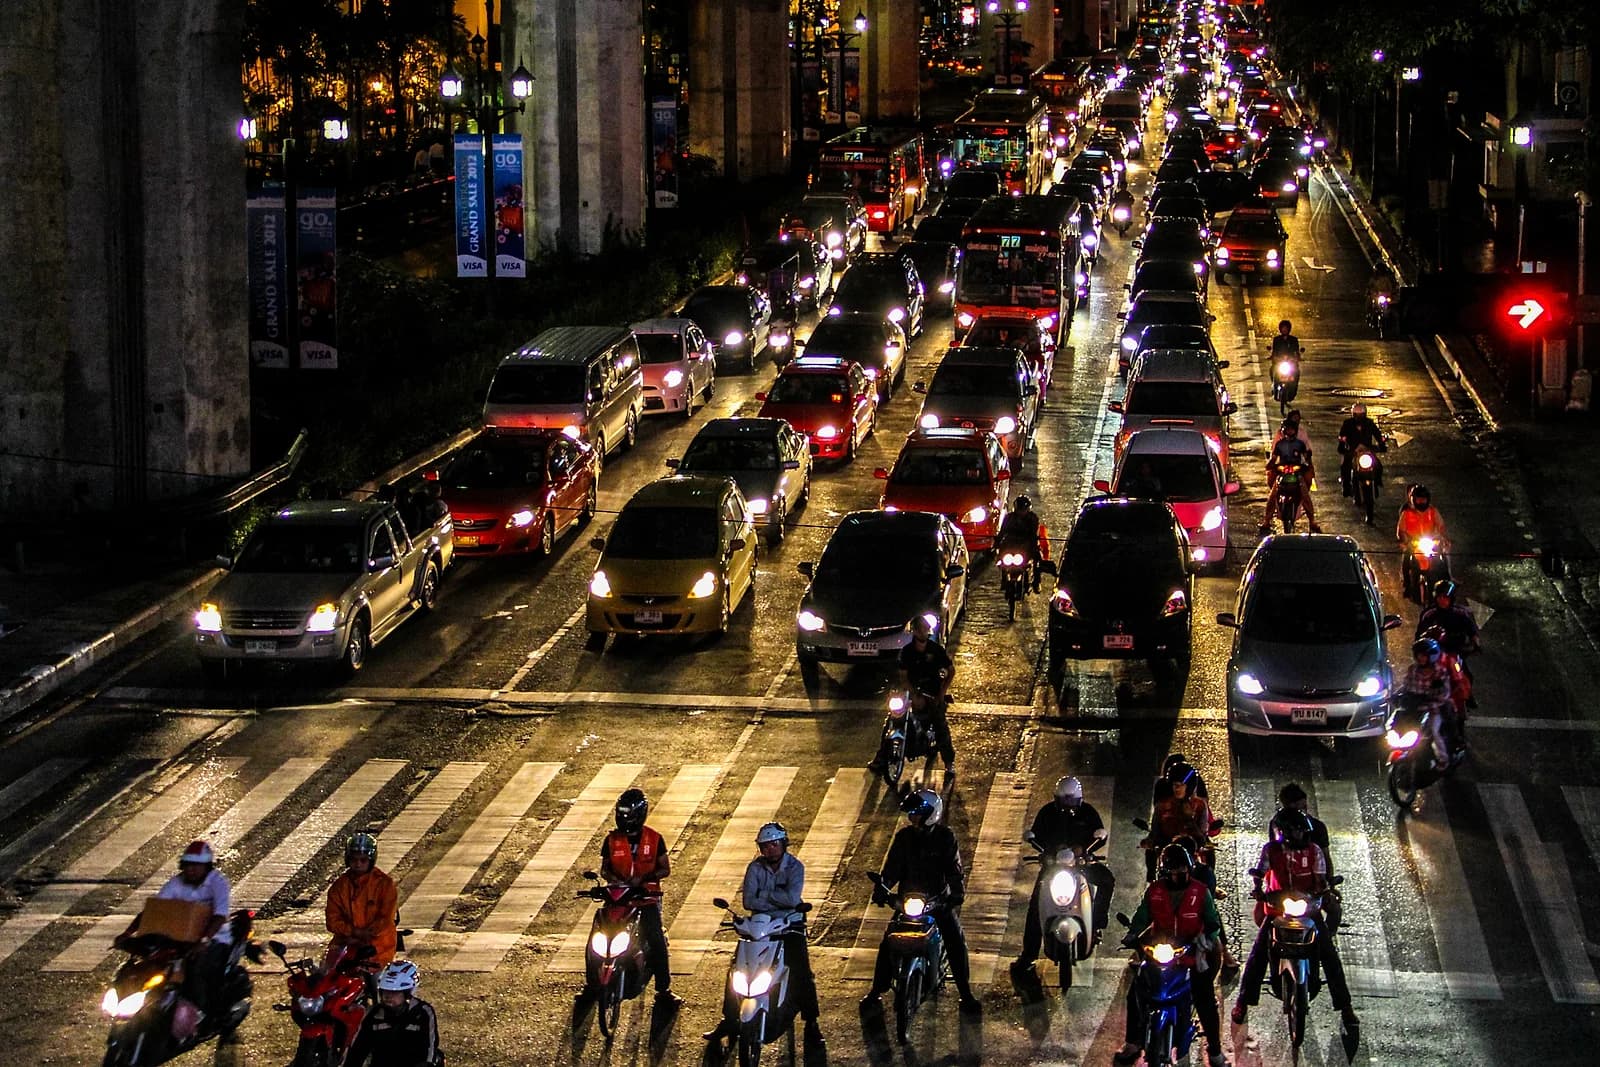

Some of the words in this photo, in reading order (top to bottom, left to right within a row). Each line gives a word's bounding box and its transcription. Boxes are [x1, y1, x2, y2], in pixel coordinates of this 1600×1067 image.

[495, 153, 520, 168] go.
[844, 152, 863, 161] 74
[467, 155, 477, 179] 2012
[468, 182, 478, 208] SALE
[300, 212, 333, 230] go.
[263, 213, 276, 246] 2012
[468, 210, 479, 253] GRAND
[1001, 235, 1020, 247] 77
[264, 249, 277, 281] SALE
[462, 262, 483, 270] VISA
[501, 262, 521, 270] VISA
[266, 284, 278, 338] GRAND
[258, 350, 283, 359] VISA
[306, 350, 332, 360] VISA
[643, 844, 651, 855] 8
